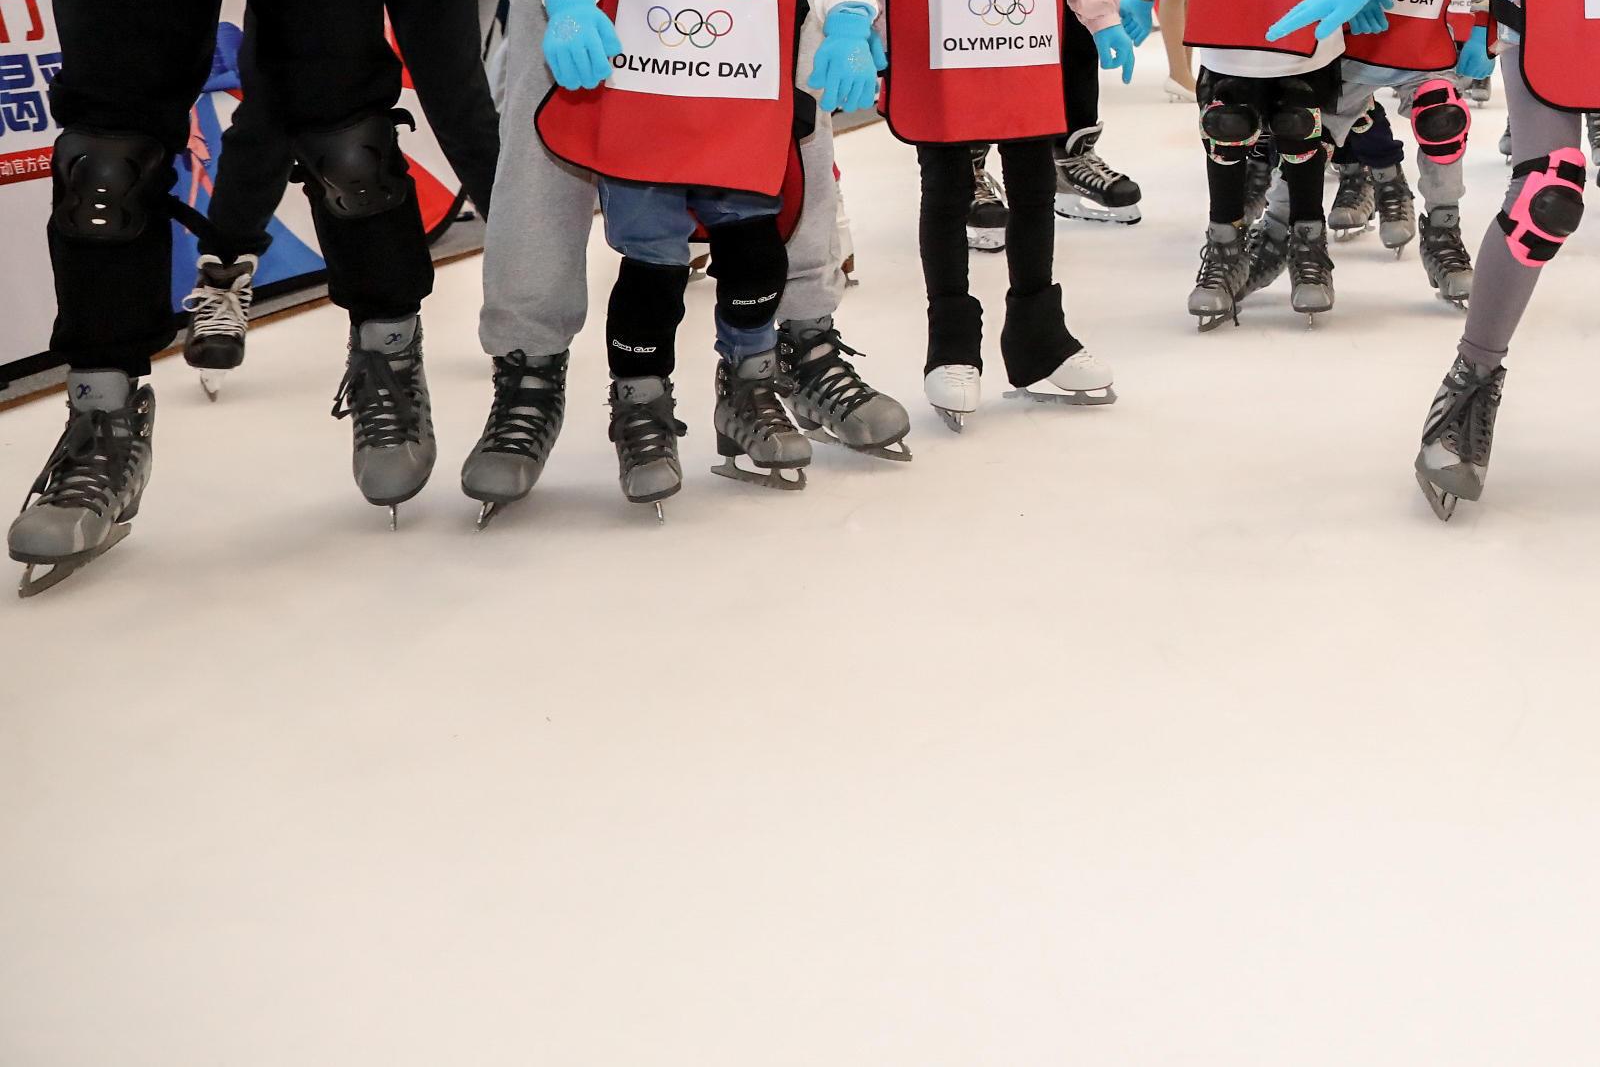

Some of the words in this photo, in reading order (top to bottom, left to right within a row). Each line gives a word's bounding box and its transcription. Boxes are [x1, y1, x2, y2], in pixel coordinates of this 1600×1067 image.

[943, 37, 1024, 52] OLYMPIC
[1029, 35, 1052, 48] DAY
[612, 53, 710, 77] OLYMPIC
[718, 63, 762, 78] DAY
